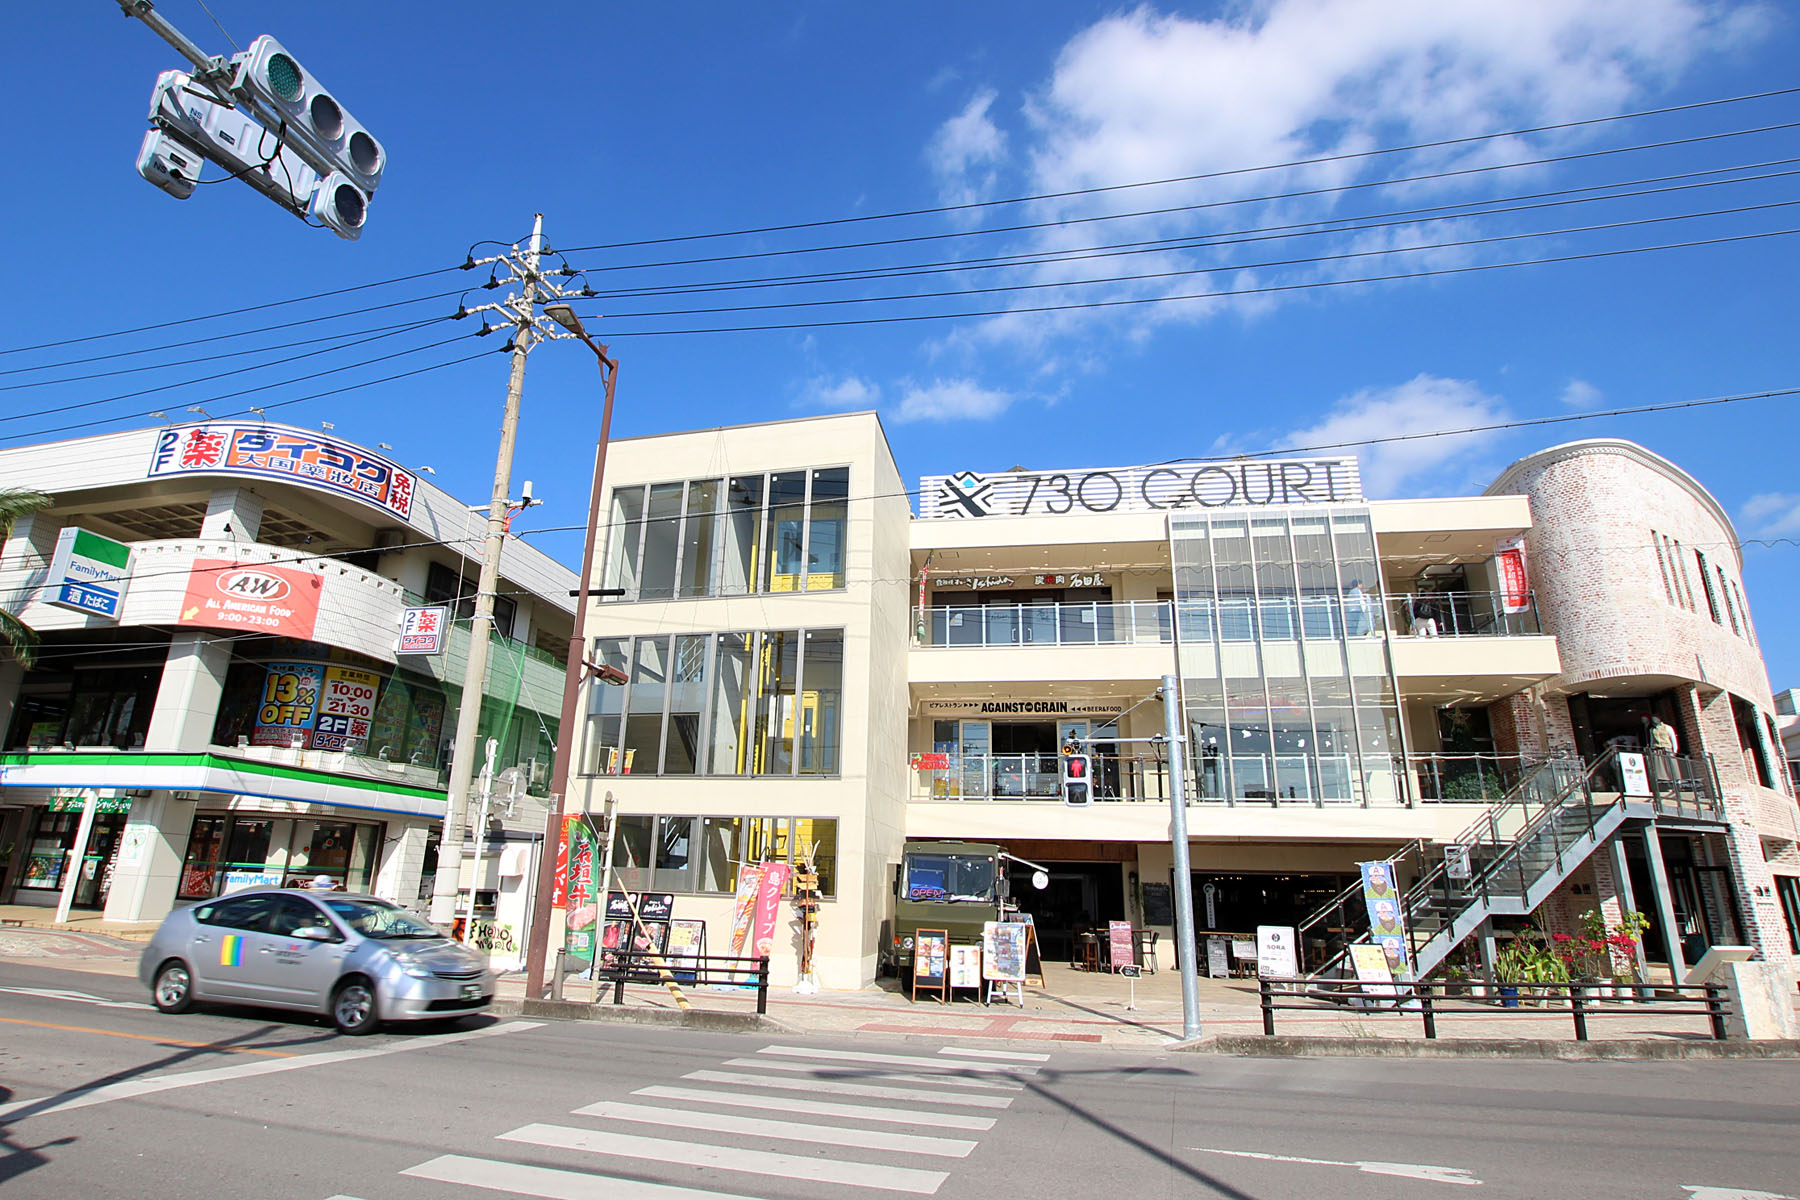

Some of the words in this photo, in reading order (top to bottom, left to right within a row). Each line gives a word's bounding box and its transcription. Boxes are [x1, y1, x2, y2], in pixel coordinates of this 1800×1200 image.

[181, 428, 225, 467] 薬
[237, 433, 388, 484] ダイコク
[389, 472, 411, 515] 免税
[1016, 472, 1123, 515] 730
[1141, 460, 1341, 509] COURT
[70, 560, 121, 584] FamilyMart
[67, 588, 83, 604] 酒
[83, 593, 111, 611] たばこ
[217, 611, 244, 623] 9:00
[247, 615, 280, 627] 23:00
[405, 611, 417, 635] 2F
[417, 609, 438, 633] 薬
[265, 673, 316, 706] 13%
[331, 684, 373, 700] 10:00
[260, 704, 313, 726] OFF
[328, 701, 370, 717] 21:30
[981, 702, 1025, 713] AGAINST
[1034, 702, 1068, 713] GRAIN
[319, 716, 348, 732] 2F
[225, 873, 279, 885] FamilyMart
[568, 843, 593, 909] 石垣牛
[762, 871, 781, 935] 島クレープ
[911, 888, 943, 898] OPEN
[479, 924, 510, 941] Hello
